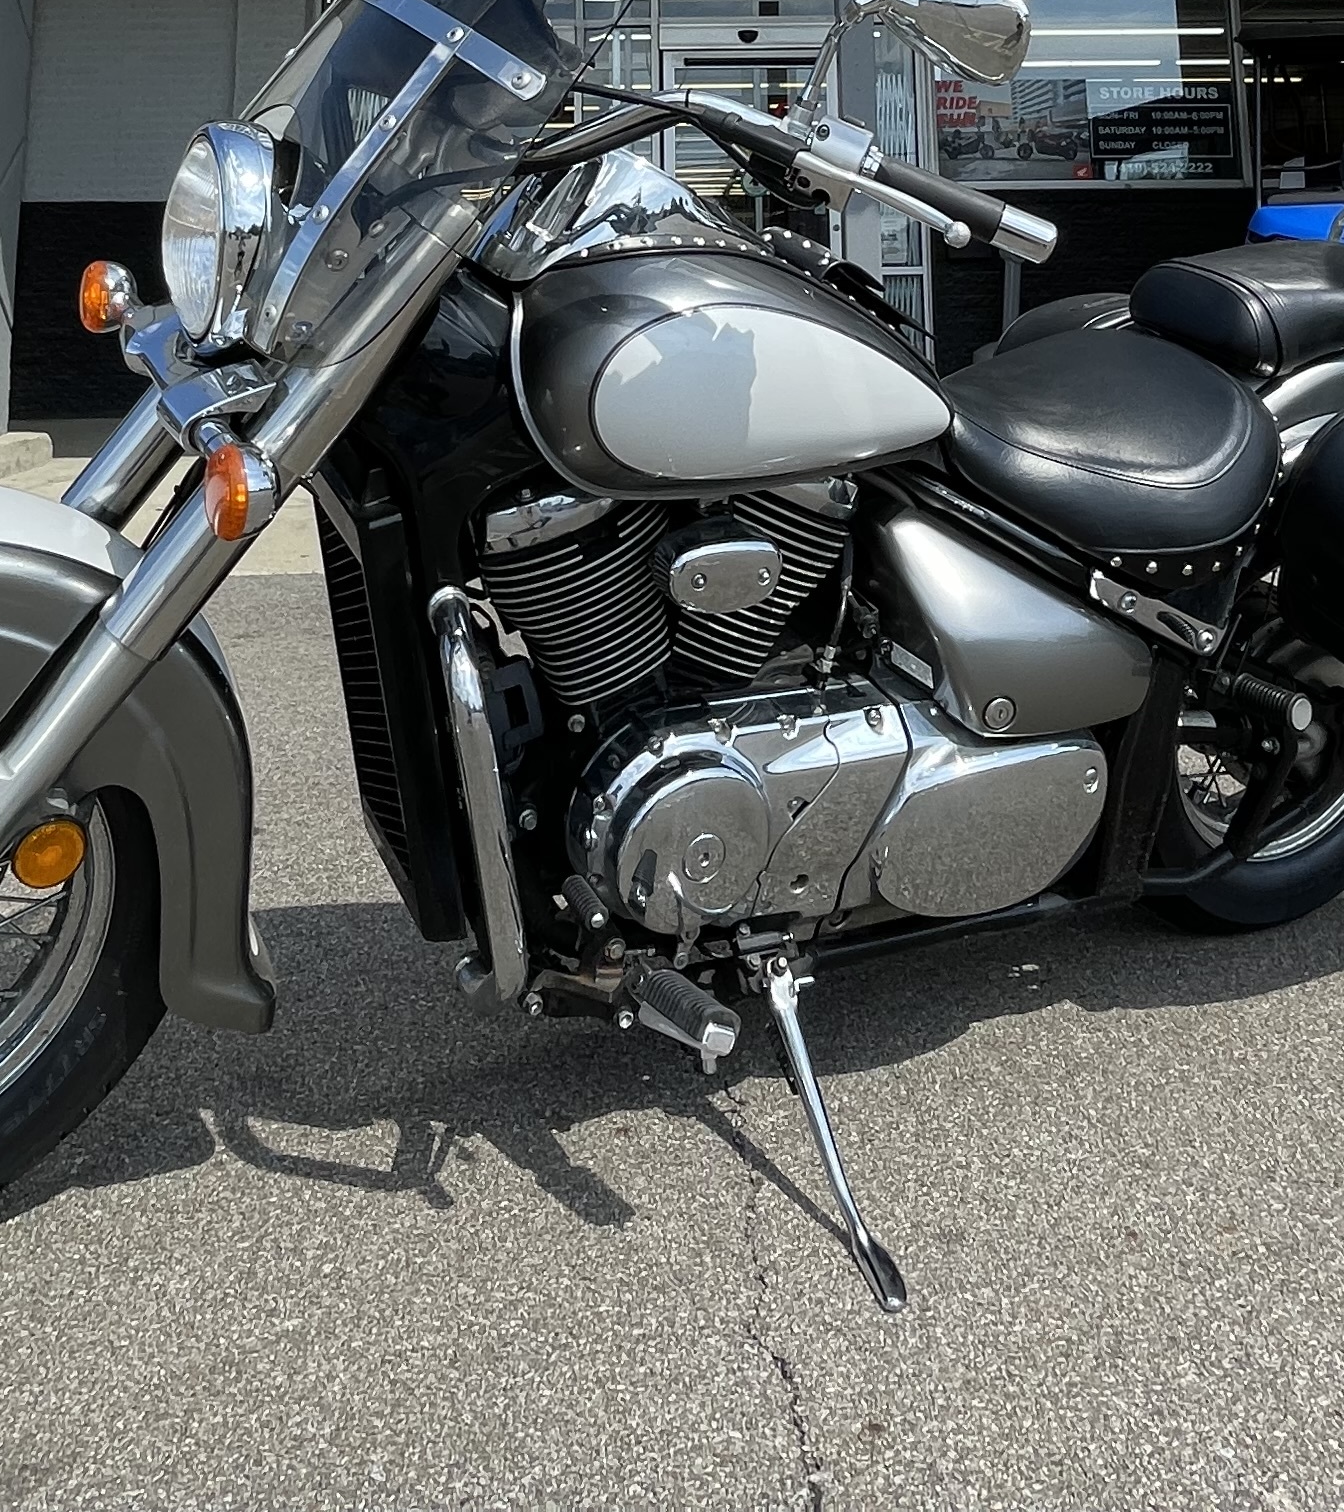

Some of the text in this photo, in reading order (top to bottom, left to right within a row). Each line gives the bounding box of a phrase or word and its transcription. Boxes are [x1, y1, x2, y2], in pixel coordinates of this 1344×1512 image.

[935, 80, 964, 93] WE
[1100, 86, 1219, 100] STORE HOURS
[937, 96, 977, 110] RIDE
[1098, 126, 1146, 135] SATURDAY
[1098, 141, 1136, 150] SUNDAY
